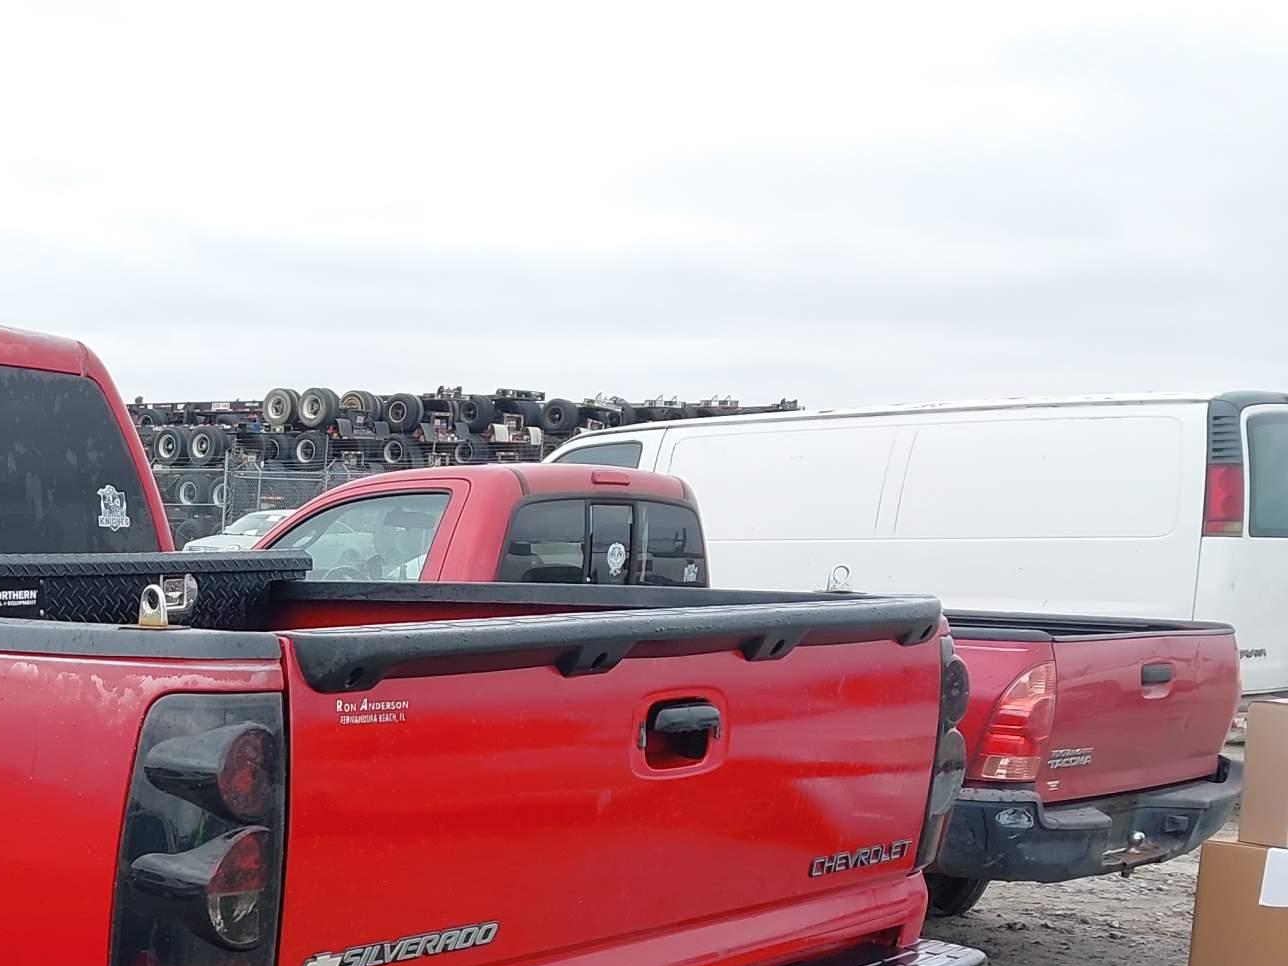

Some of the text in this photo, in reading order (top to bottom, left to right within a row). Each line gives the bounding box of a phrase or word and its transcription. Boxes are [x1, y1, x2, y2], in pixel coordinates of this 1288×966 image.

[399, 712, 406, 722] FL
[1048, 755, 1092, 769] TACOMA
[810, 839, 913, 877] CHEVROLET
